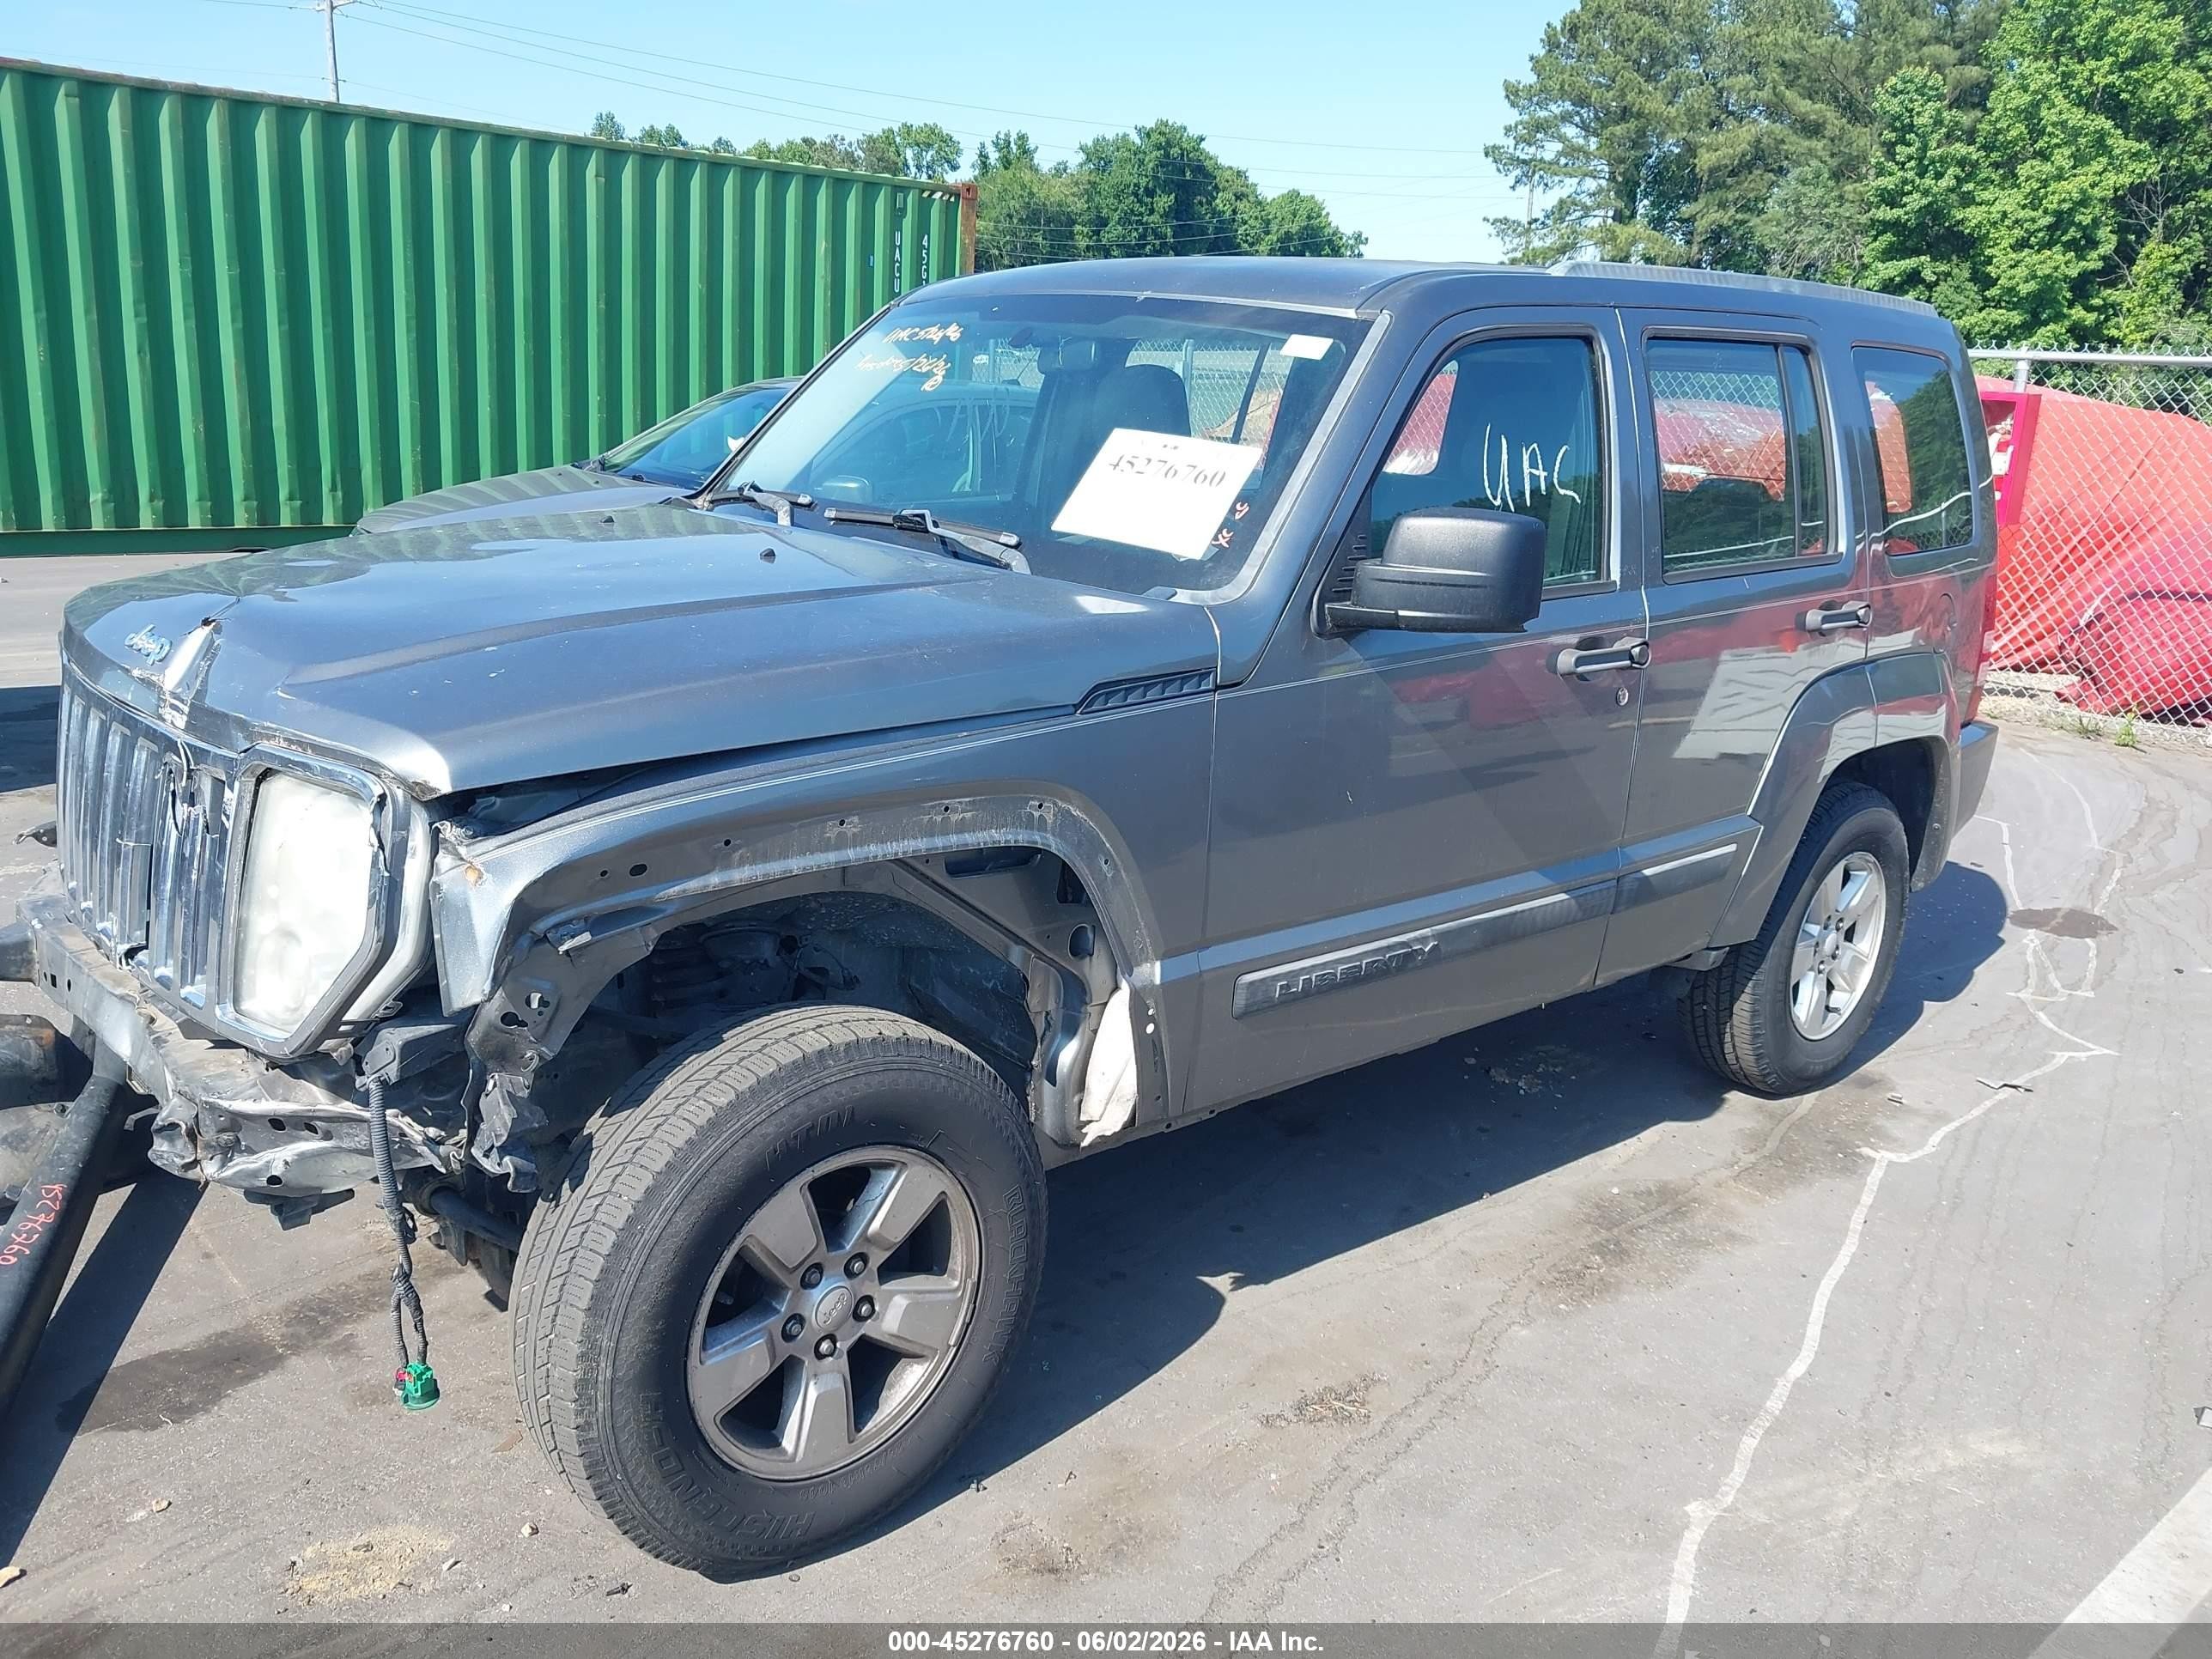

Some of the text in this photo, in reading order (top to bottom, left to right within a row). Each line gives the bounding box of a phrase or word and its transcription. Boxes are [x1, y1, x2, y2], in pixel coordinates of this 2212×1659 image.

[1109, 454, 1226, 487] 45276760
[1484, 422, 1581, 513] UAC
[1274, 941, 1438, 1000] LIBERTY
[823, 1292, 848, 1325] Jeep
